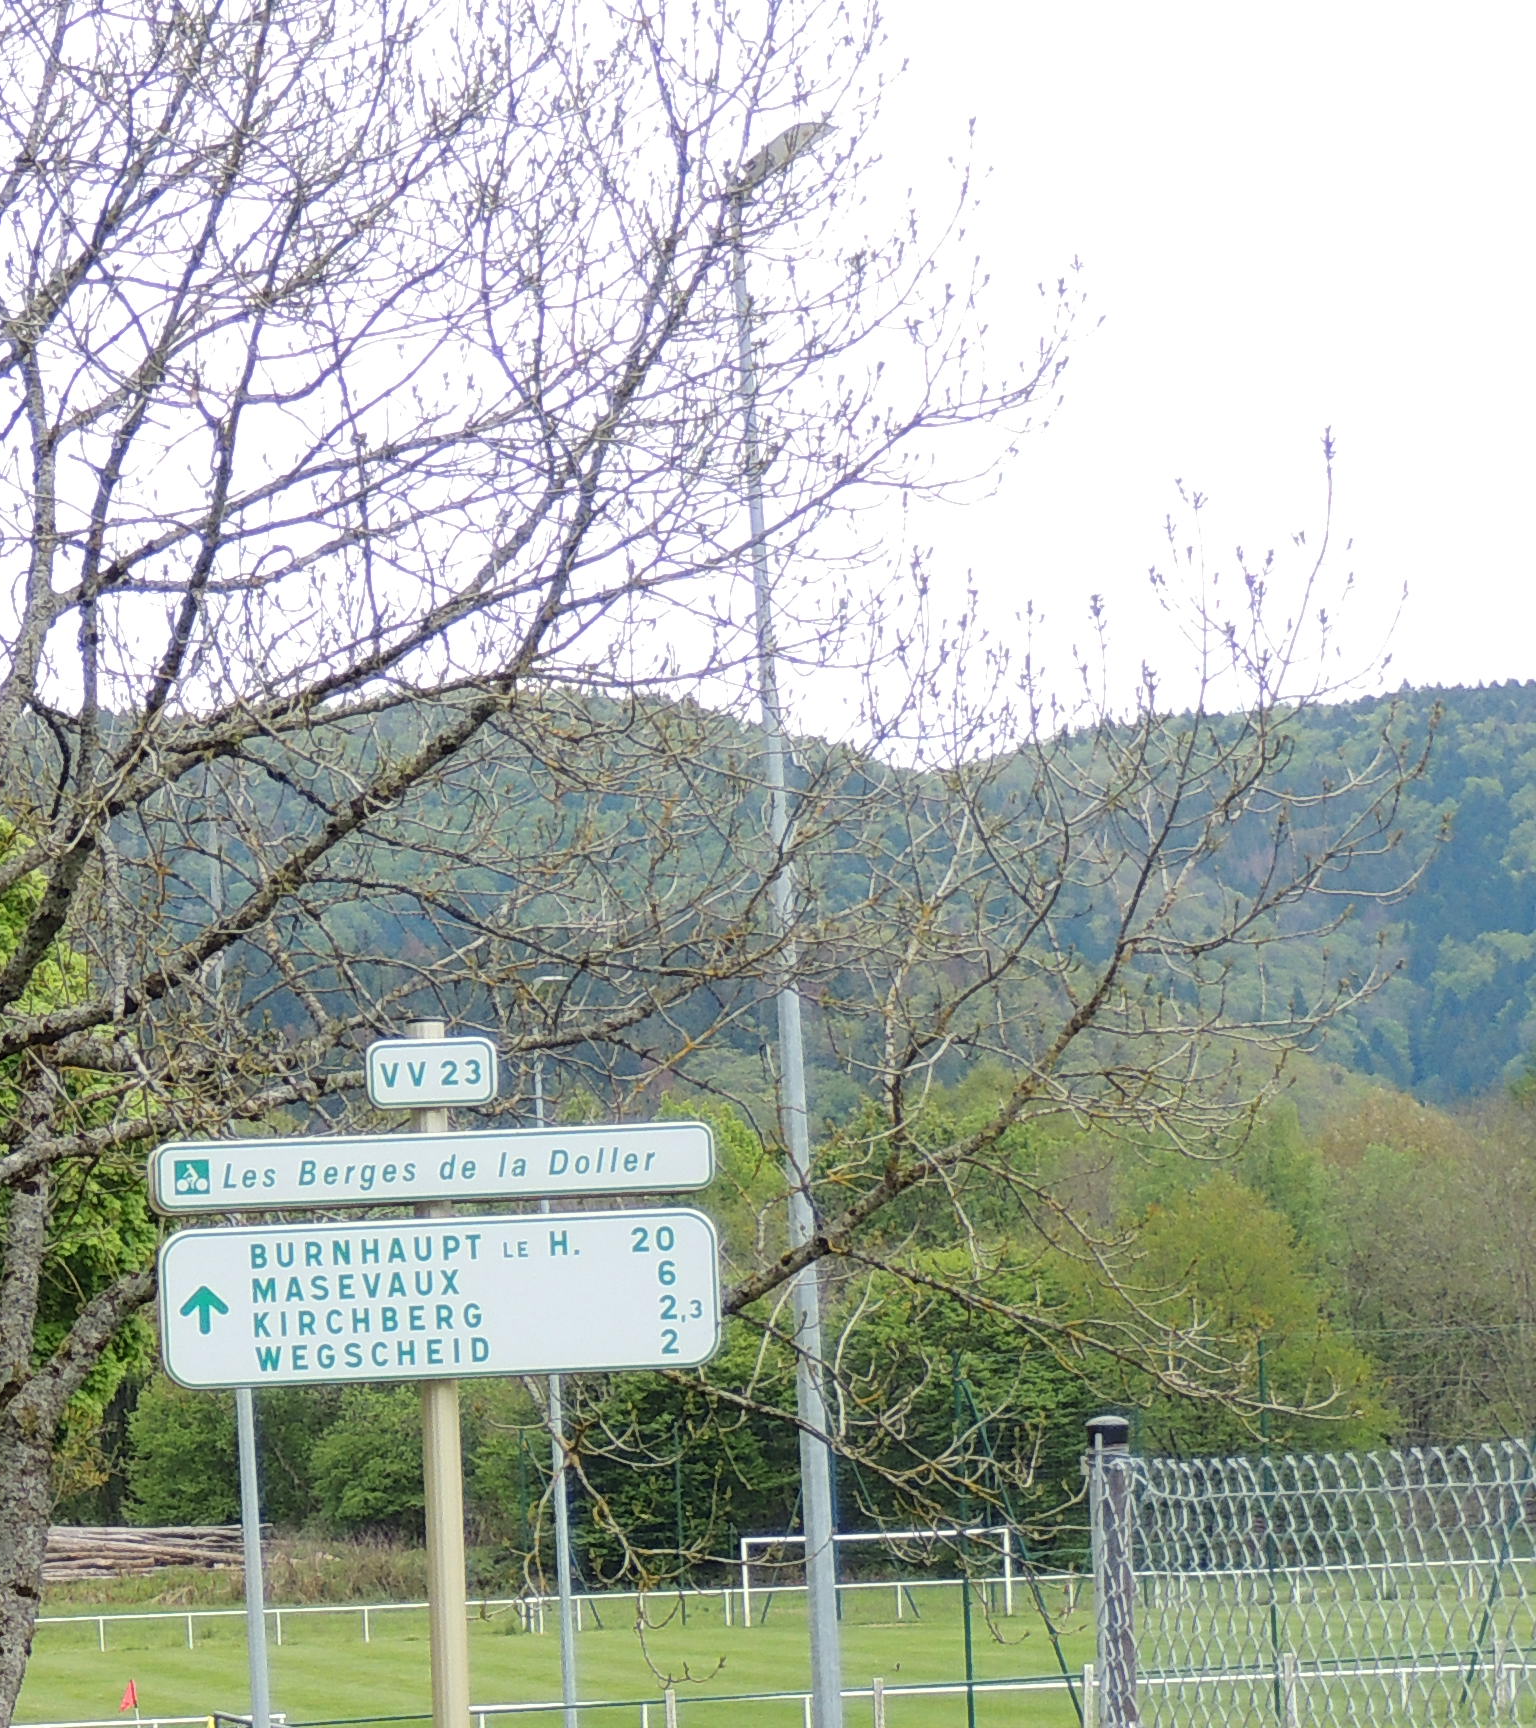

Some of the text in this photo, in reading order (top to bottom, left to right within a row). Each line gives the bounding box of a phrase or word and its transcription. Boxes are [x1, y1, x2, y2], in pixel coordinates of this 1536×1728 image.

[380, 1059, 482, 1089] VV 23
[223, 1147, 656, 1189] Les Berges de la Doller
[250, 1225, 675, 1269] BURNHAUPT LE H. 20
[251, 1260, 677, 1304] MASEVAUX 6
[253, 1294, 703, 1338] KIRCHBERG 2,3
[255, 1328, 680, 1372] WEGSCHEID 2
